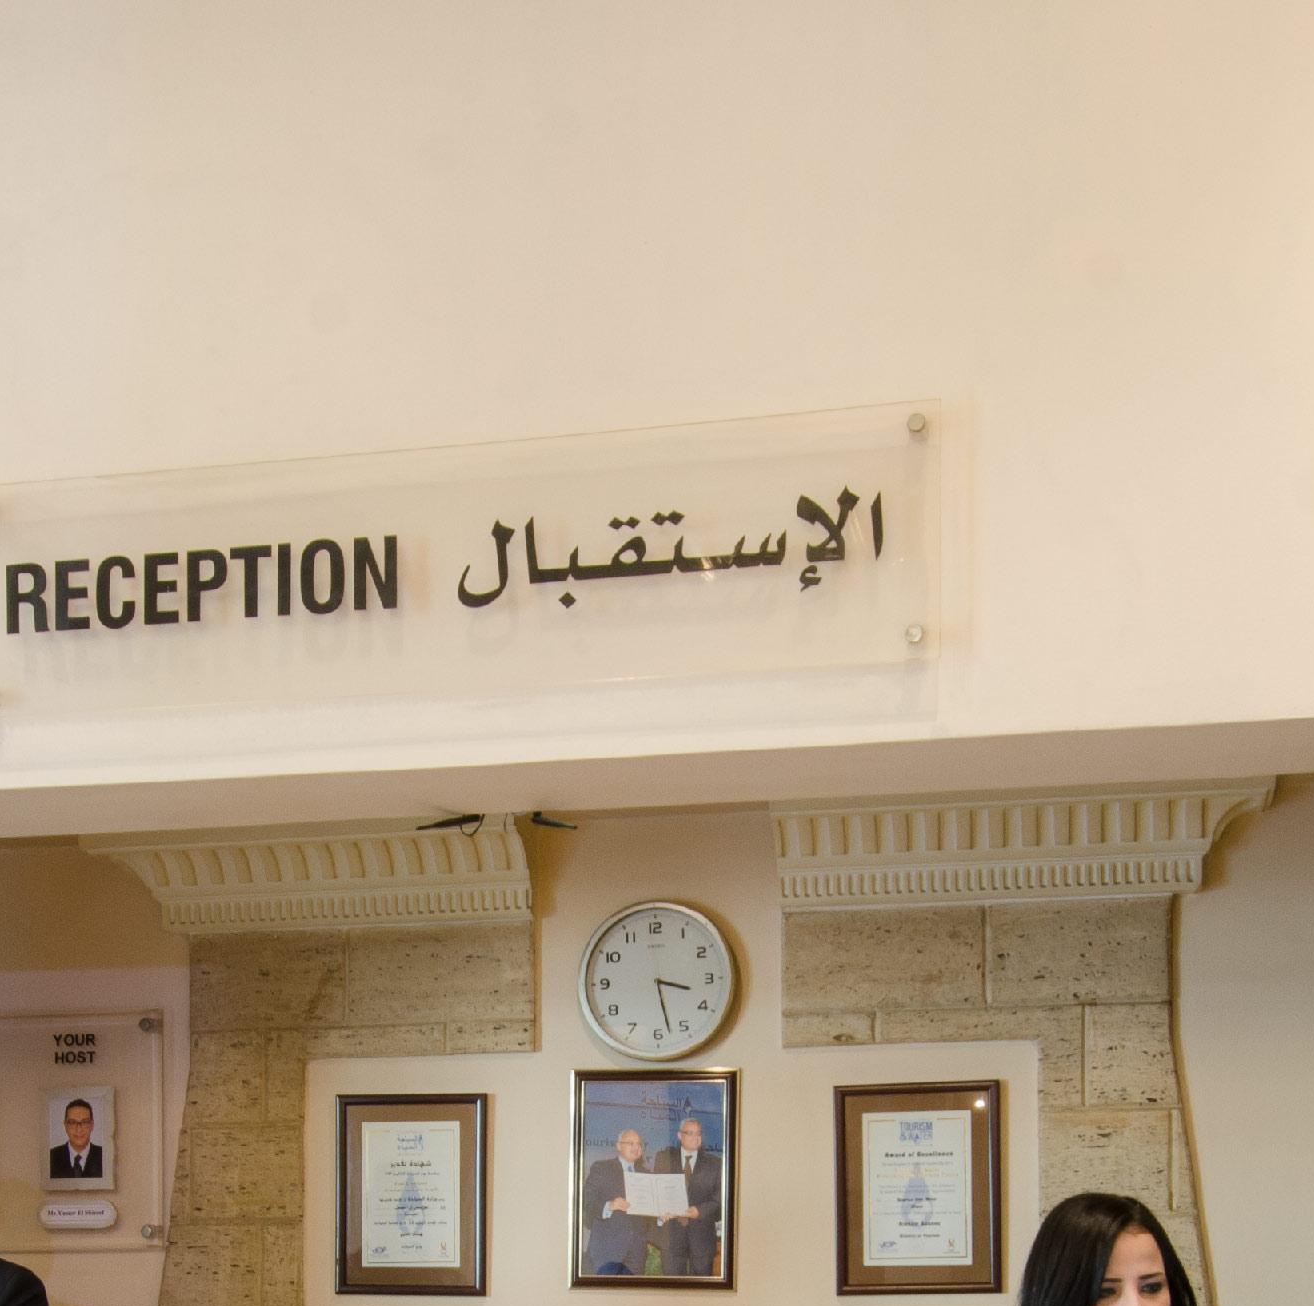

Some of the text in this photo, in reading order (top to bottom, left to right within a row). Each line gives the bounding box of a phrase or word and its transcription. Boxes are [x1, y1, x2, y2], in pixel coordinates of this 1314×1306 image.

[458, 486, 884, 608] الإستقبال
[5, 535, 398, 635] RECEPTION
[649, 921, 662, 934] 12
[681, 927, 685, 939] 1
[625, 932, 636, 943] 11
[606, 951, 621, 963] 10
[696, 946, 707, 958] 2
[600, 978, 610, 990] 9
[704, 973, 714, 984] 3
[608, 1004, 619, 1016] 8
[697, 1000, 708, 1011] 4
[627, 1022, 637, 1034] 7
[679, 1020, 690, 1032] 5
[53, 1033, 96, 1047] YOUR
[653, 1029, 664, 1040] 6
[54, 1051, 96, 1064] HOST
[899, 1121, 933, 1131] TOURISM
